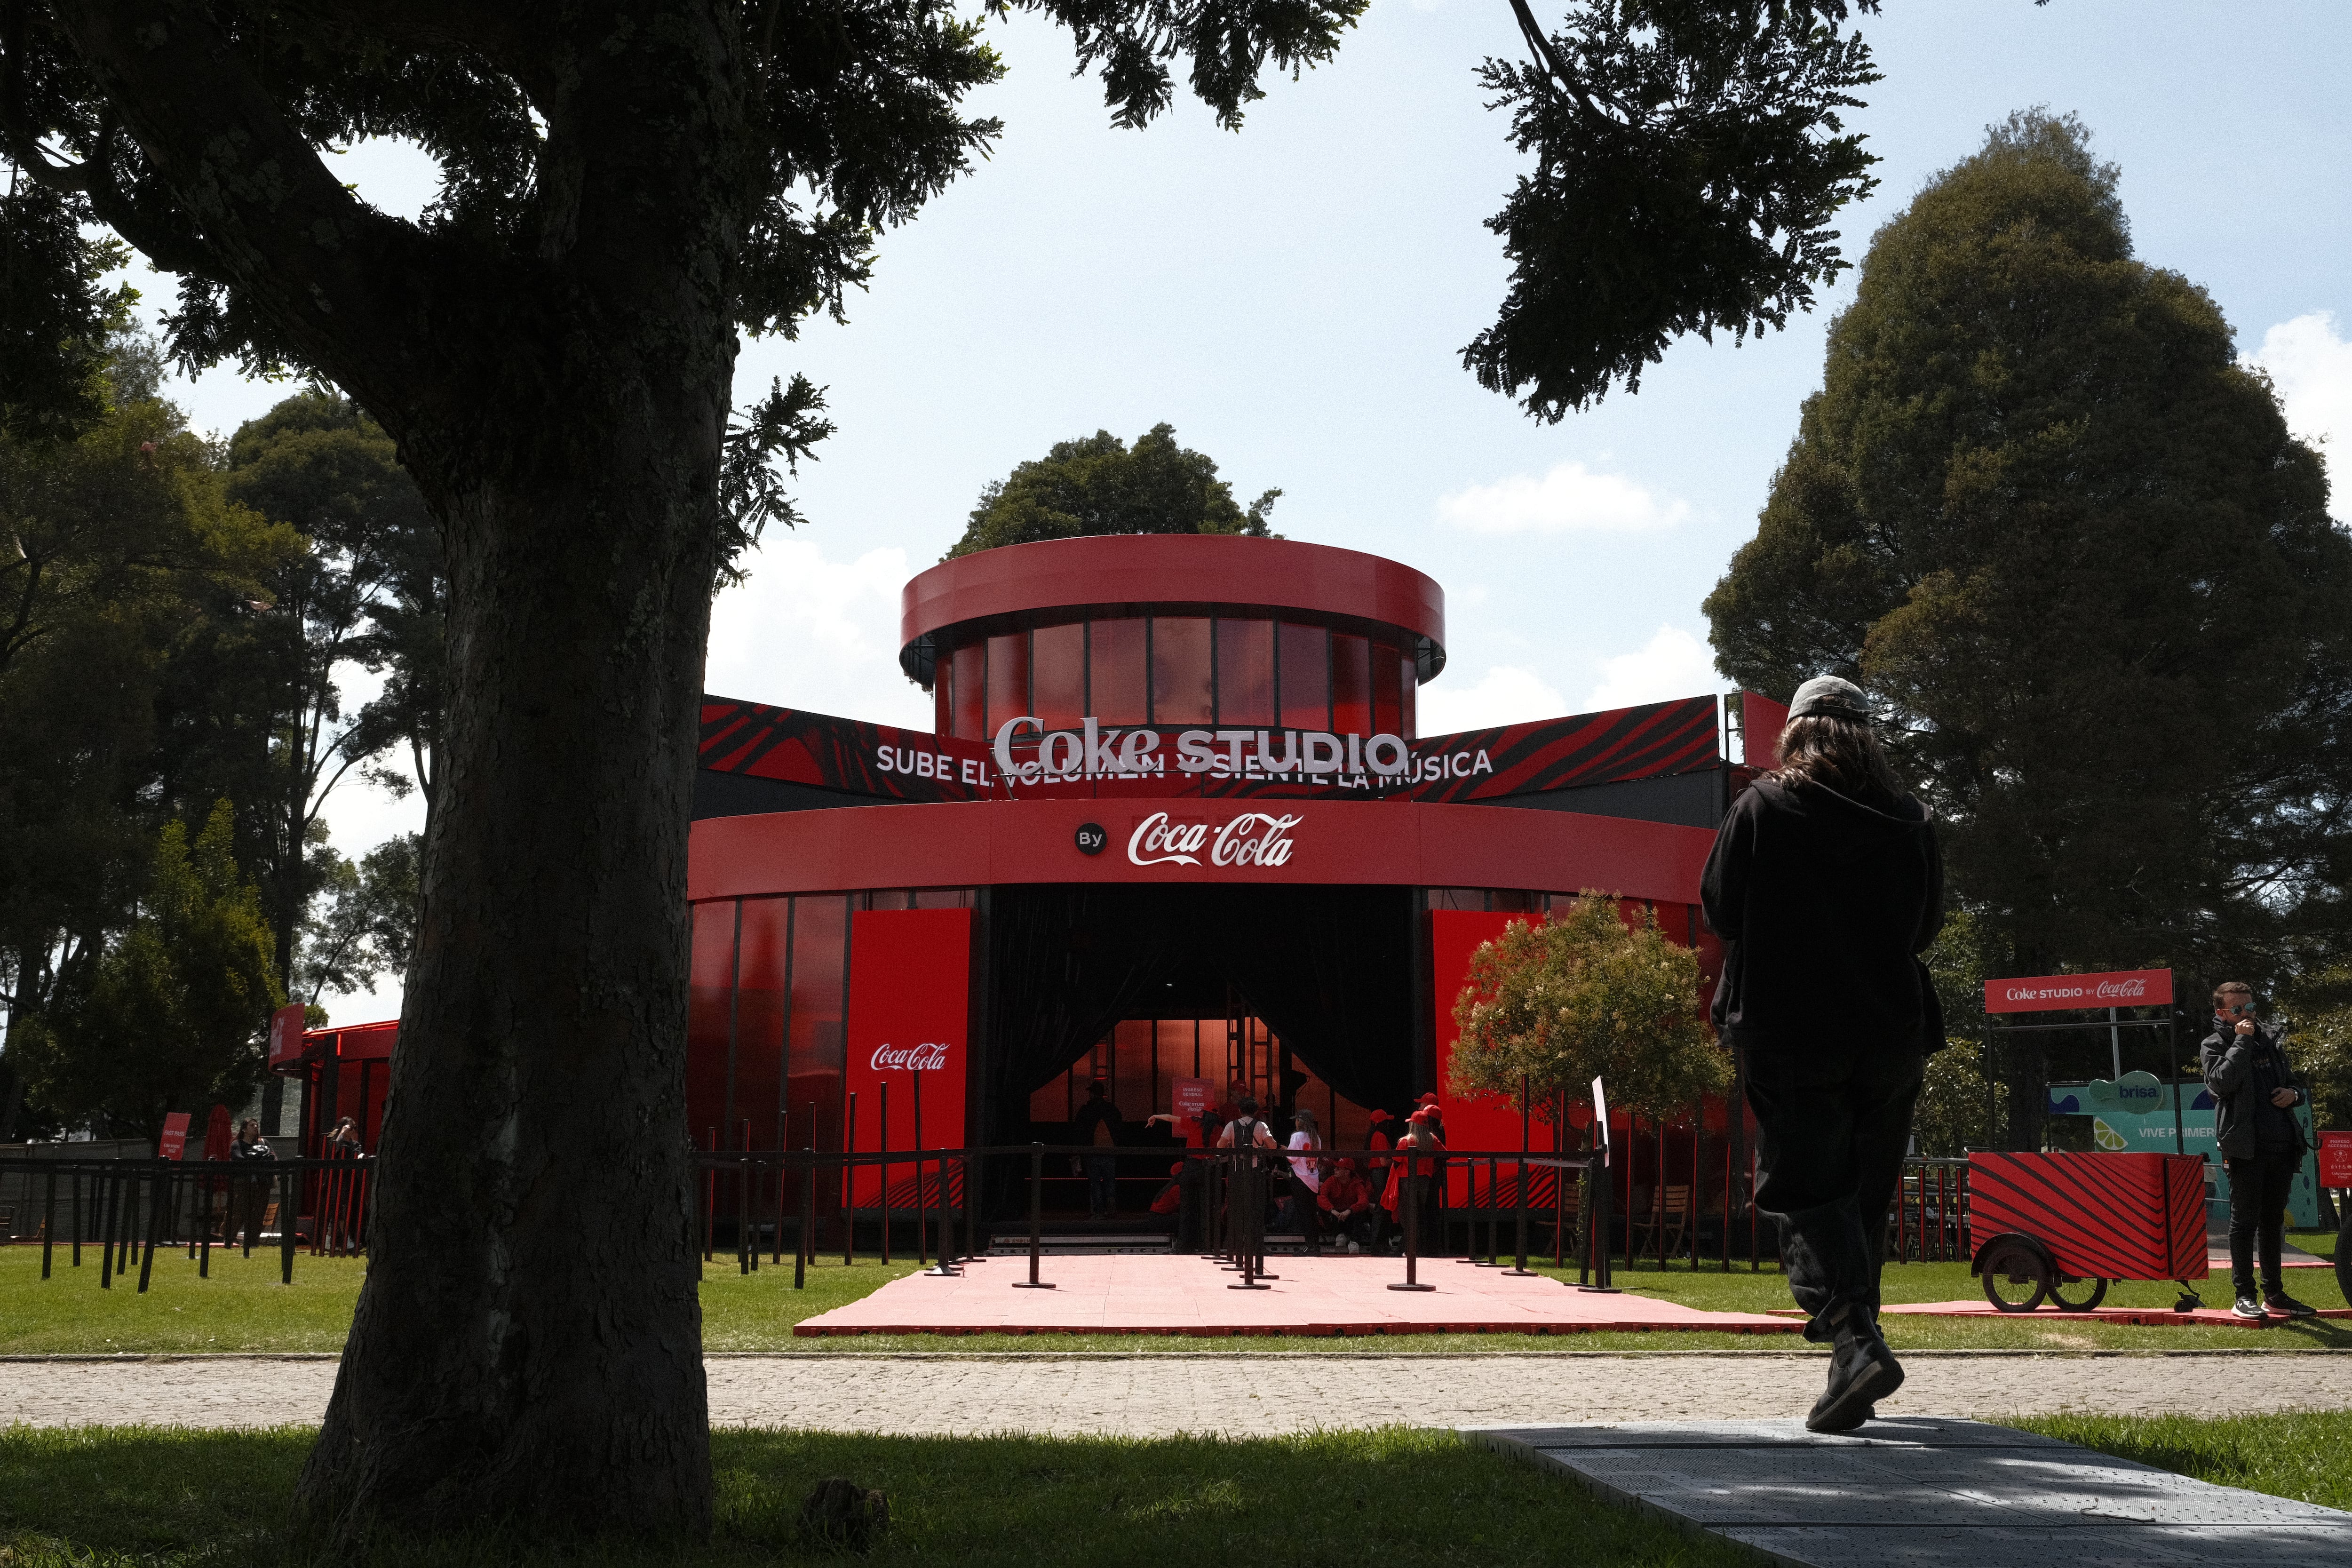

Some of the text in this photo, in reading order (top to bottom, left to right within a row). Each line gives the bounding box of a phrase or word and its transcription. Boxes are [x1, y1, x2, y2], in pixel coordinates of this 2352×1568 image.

[994, 716, 1408, 776] Coke STUDIO
[876, 745, 953, 781] SUBE
[961, 759, 994, 788] EL
[1338, 762, 1370, 790] LA
[1079, 812, 1304, 867] By Coca-Cola
[2006, 988, 2037, 1000] Coke
[2039, 987, 2083, 998] STUDIO
[2097, 979, 2147, 998] Coca-Cola
[871, 1043, 951, 1070] Coca-Cola
[2119, 1085, 2157, 1098] brisa
[2138, 1127, 2217, 1138] VIVE PIMER
